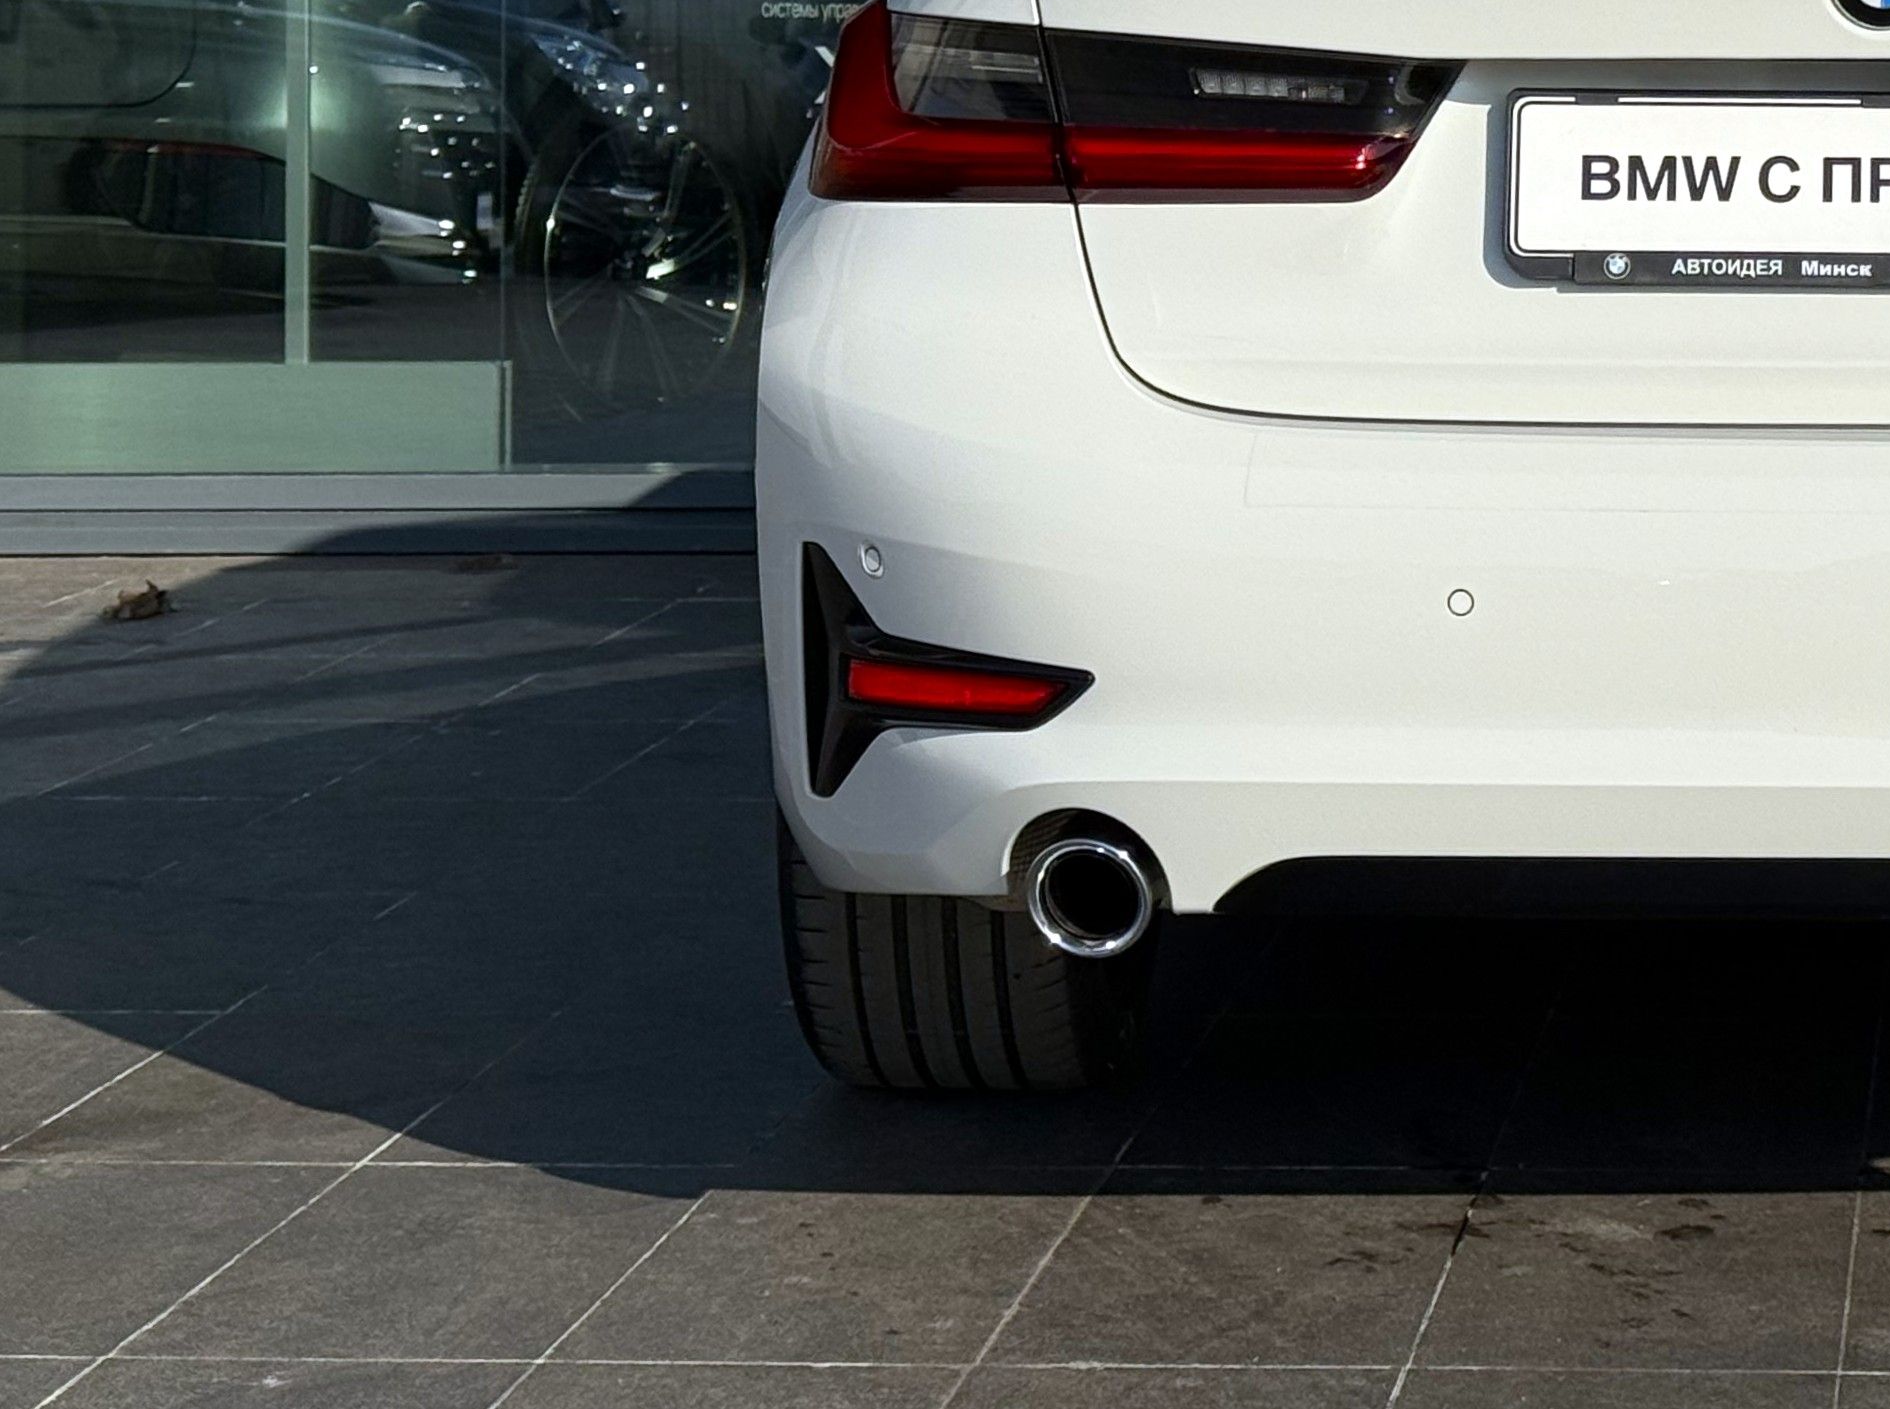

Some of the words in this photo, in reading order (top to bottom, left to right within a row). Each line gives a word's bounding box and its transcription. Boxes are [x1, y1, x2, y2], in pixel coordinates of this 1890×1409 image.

[760, 0, 820, 19] системы
[1581, 154, 1741, 203] BMW
[1758, 156, 1801, 204] С
[1671, 257, 1784, 279] АВТОИДЕЯ
[1800, 258, 1873, 279] Минск
